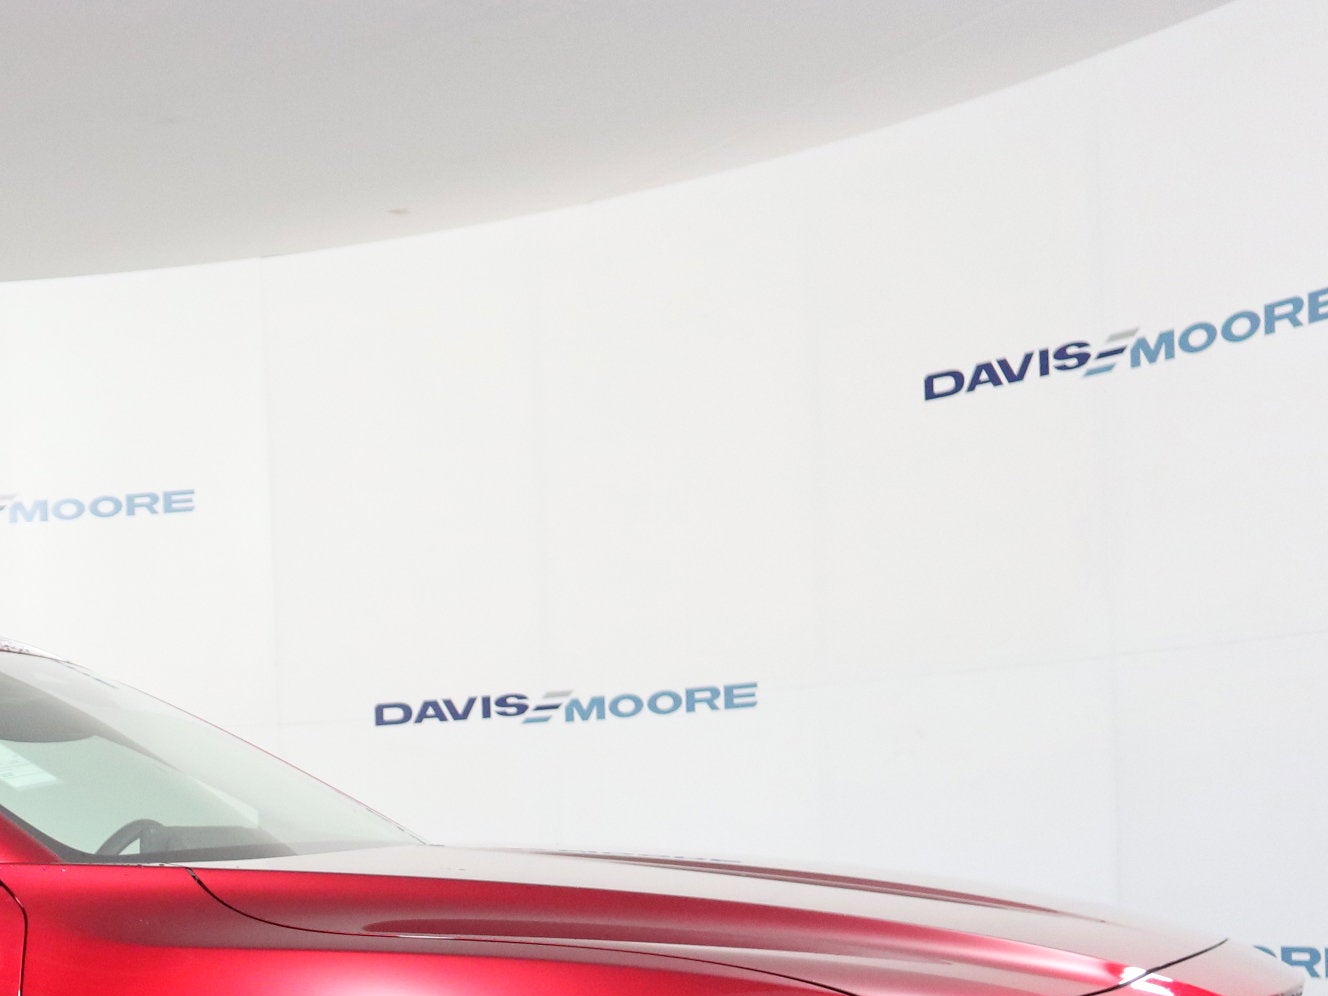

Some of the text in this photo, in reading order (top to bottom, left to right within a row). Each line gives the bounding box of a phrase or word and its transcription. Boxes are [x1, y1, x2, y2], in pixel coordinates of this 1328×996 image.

[923, 287, 1328, 401] DAVIS MOORE
[9, 488, 196, 523] MOORE
[374, 681, 759, 727] DAVIS MOORE
